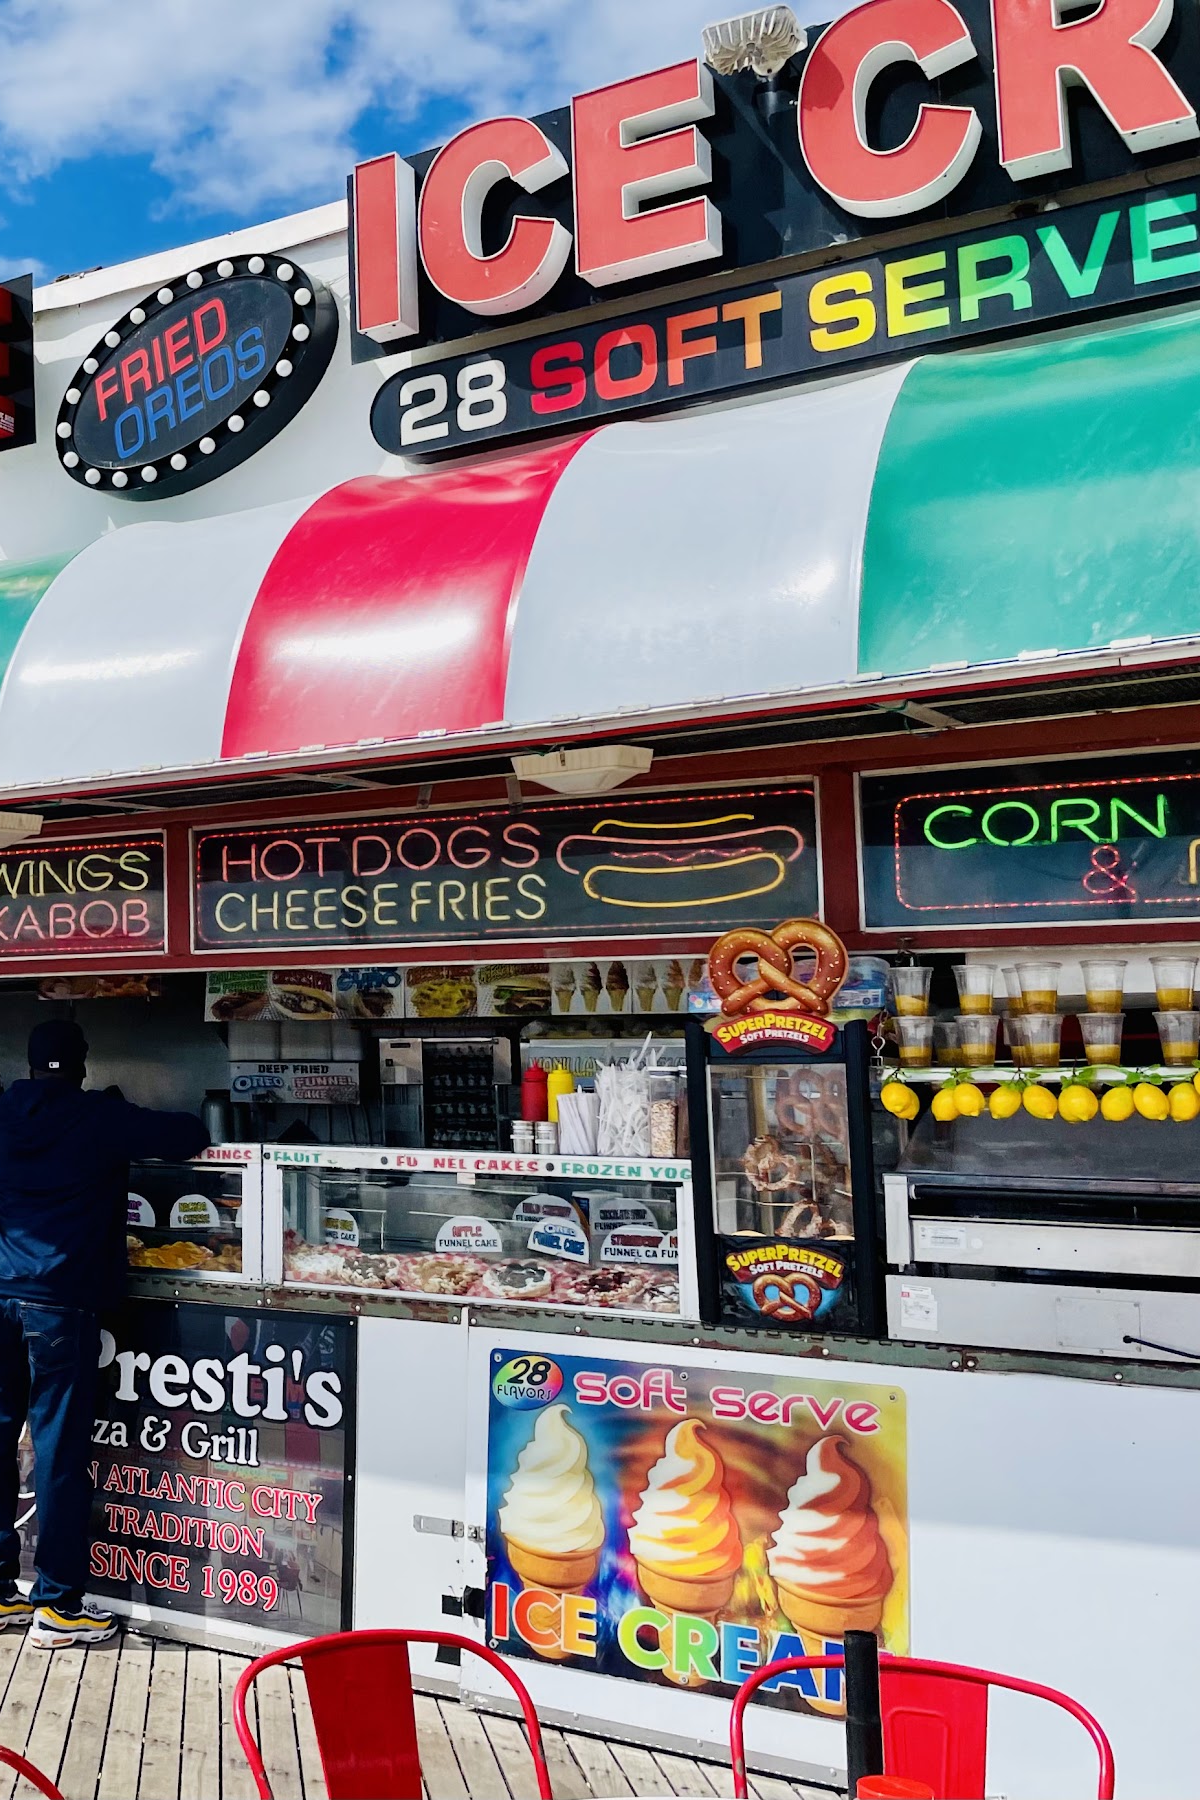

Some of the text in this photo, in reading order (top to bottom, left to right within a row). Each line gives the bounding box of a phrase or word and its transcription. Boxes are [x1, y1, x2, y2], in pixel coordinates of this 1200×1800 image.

[352, 57, 712, 336] ICE
[400, 192, 1200, 445] 28 SOFT SERVE
[95, 298, 228, 422] FRIED
[114, 326, 266, 459] OREOS
[924, 794, 1167, 849] CORN
[222, 822, 540, 882] HOT DOGS
[1083, 845, 1137, 901] &
[215, 874, 547, 933] CHEESE FRIES
[234, 1075, 284, 1092] OREO
[258, 1064, 329, 1074] DEEP FRIED
[207, 1150, 252, 1160] RINGS
[396, 1156, 468, 1170] FUNEL
[474, 1159, 539, 1172] CAKES
[561, 1162, 641, 1177] FROZEN
[439, 1239, 498, 1248] FUNNEL CAKE
[604, 1248, 641, 1257] FUNNEL
[726, 1244, 844, 1278] SUPERPRETZEL
[749, 1262, 774, 1275] SOFT
[497, 1384, 553, 1400] FLAVORS
[507, 1358, 551, 1386] 28
[140, 1415, 172, 1452] &
[181, 1421, 259, 1467] Grill
[104, 1464, 246, 1512] ATLANTIC
[251, 1484, 323, 1524] CITY
[105, 1503, 264, 1560] TRADITION
[90, 1542, 280, 1612] SINCE 1989
[491, 1582, 597, 1658] ICE
